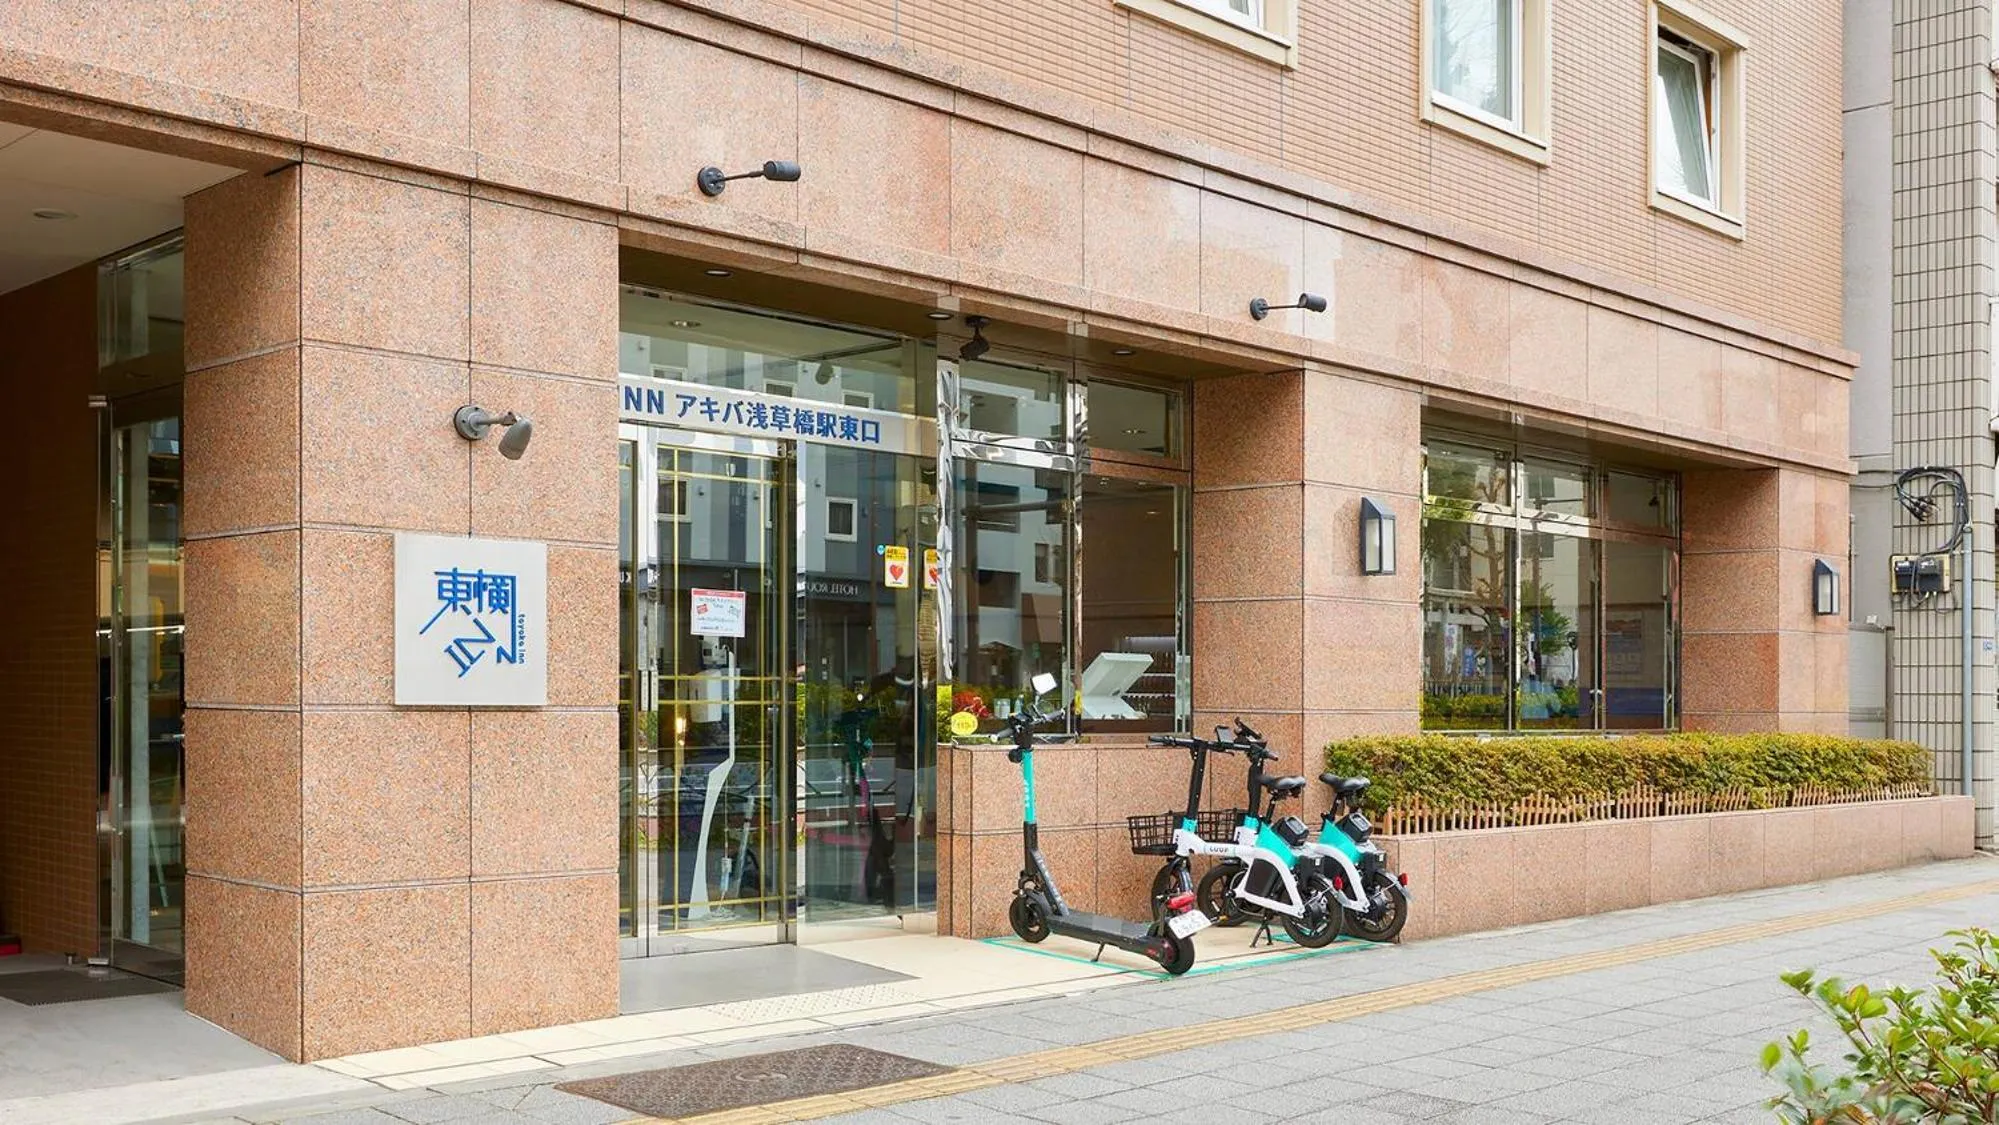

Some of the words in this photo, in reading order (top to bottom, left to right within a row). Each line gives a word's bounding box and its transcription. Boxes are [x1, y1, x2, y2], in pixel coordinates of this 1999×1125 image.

[676, 393, 880, 443] アキバ浅草橋駅東口
